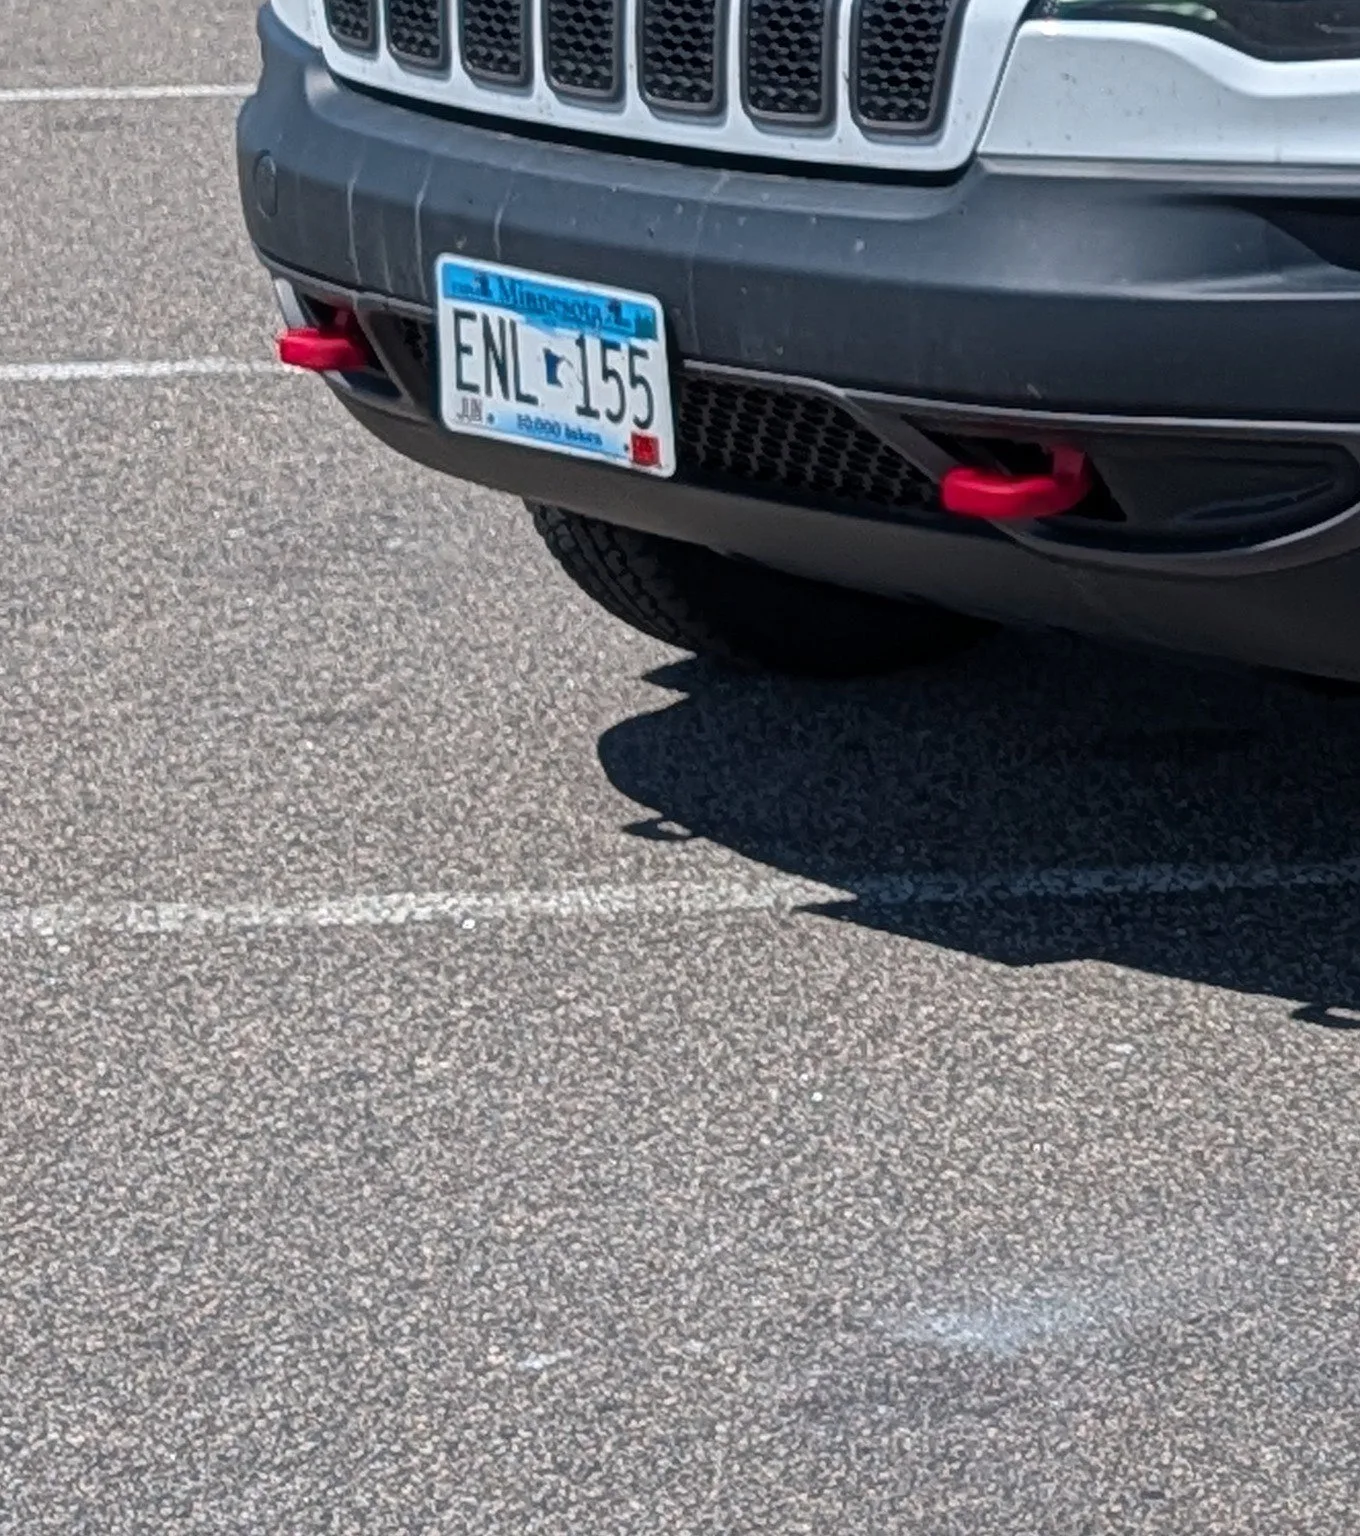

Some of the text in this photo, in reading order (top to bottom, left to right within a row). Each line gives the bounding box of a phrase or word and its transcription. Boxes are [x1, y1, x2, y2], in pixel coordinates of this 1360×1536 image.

[497, 274, 603, 326] Minnesota
[453, 308, 655, 430] ENL 155
